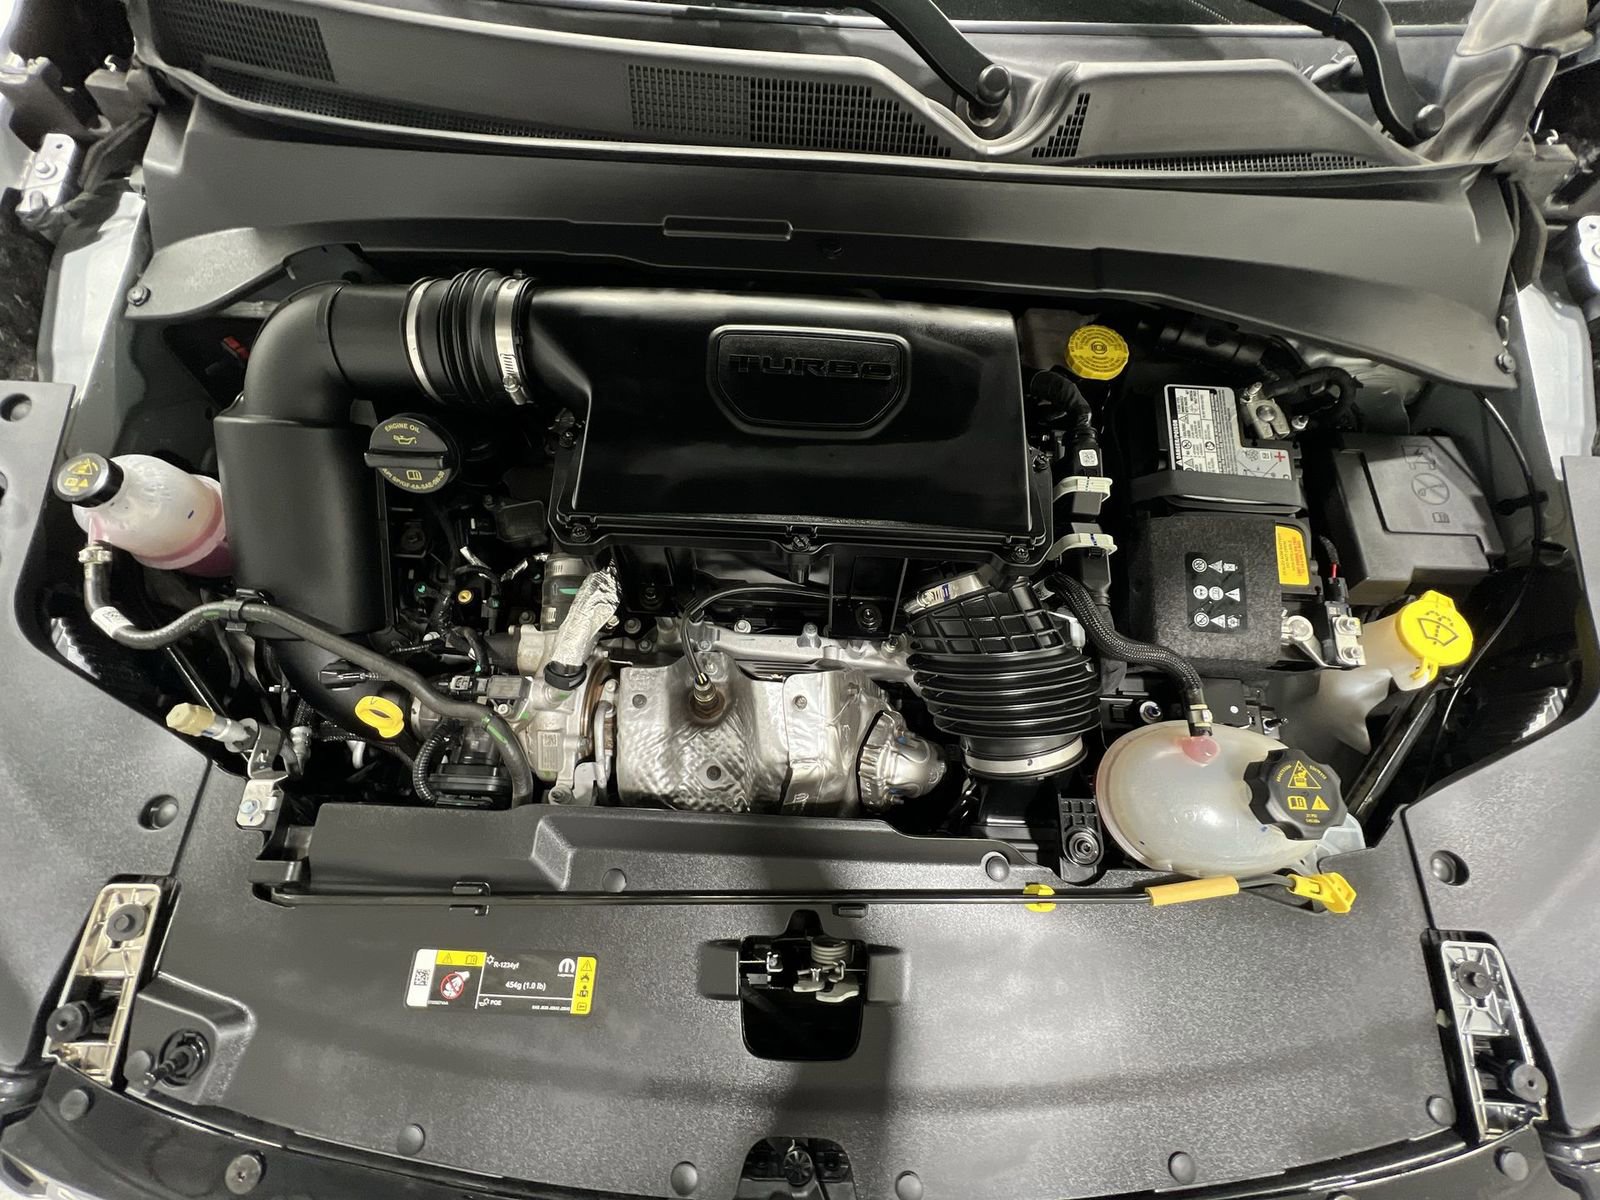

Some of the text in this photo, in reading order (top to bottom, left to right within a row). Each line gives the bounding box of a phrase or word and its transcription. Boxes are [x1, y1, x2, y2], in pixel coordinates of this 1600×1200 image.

[729, 354, 892, 380] TURBO
[384, 423, 421, 434] ENGINE OIL
[493, 960, 520, 970] R-1234yf
[505, 981, 547, 991] 454g (1.0 lb)
